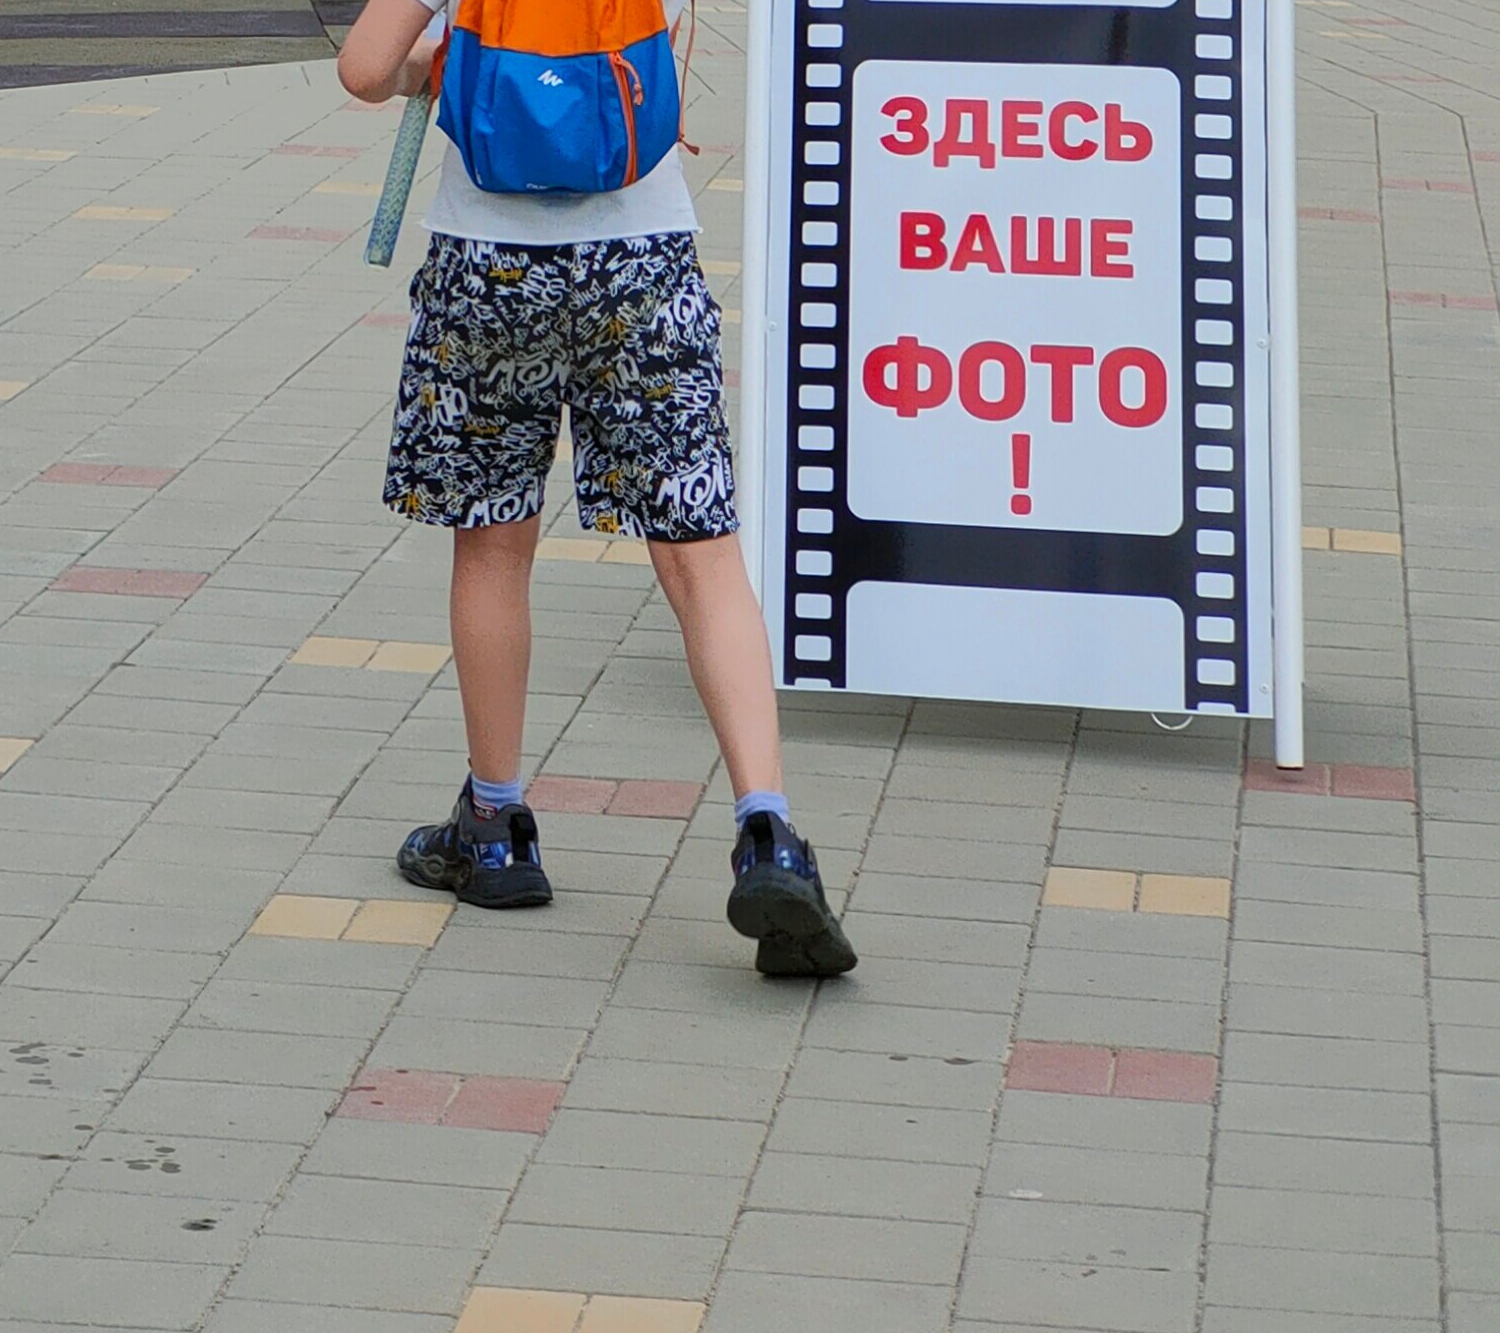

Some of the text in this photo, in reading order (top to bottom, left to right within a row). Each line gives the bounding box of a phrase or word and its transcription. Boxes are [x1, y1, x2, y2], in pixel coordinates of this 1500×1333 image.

[879, 96, 1154, 169] ЗДЕСЬ
[899, 211, 1135, 280] ВАШЕ
[861, 335, 1168, 428] ФОТО
[1009, 432, 1033, 516] !
